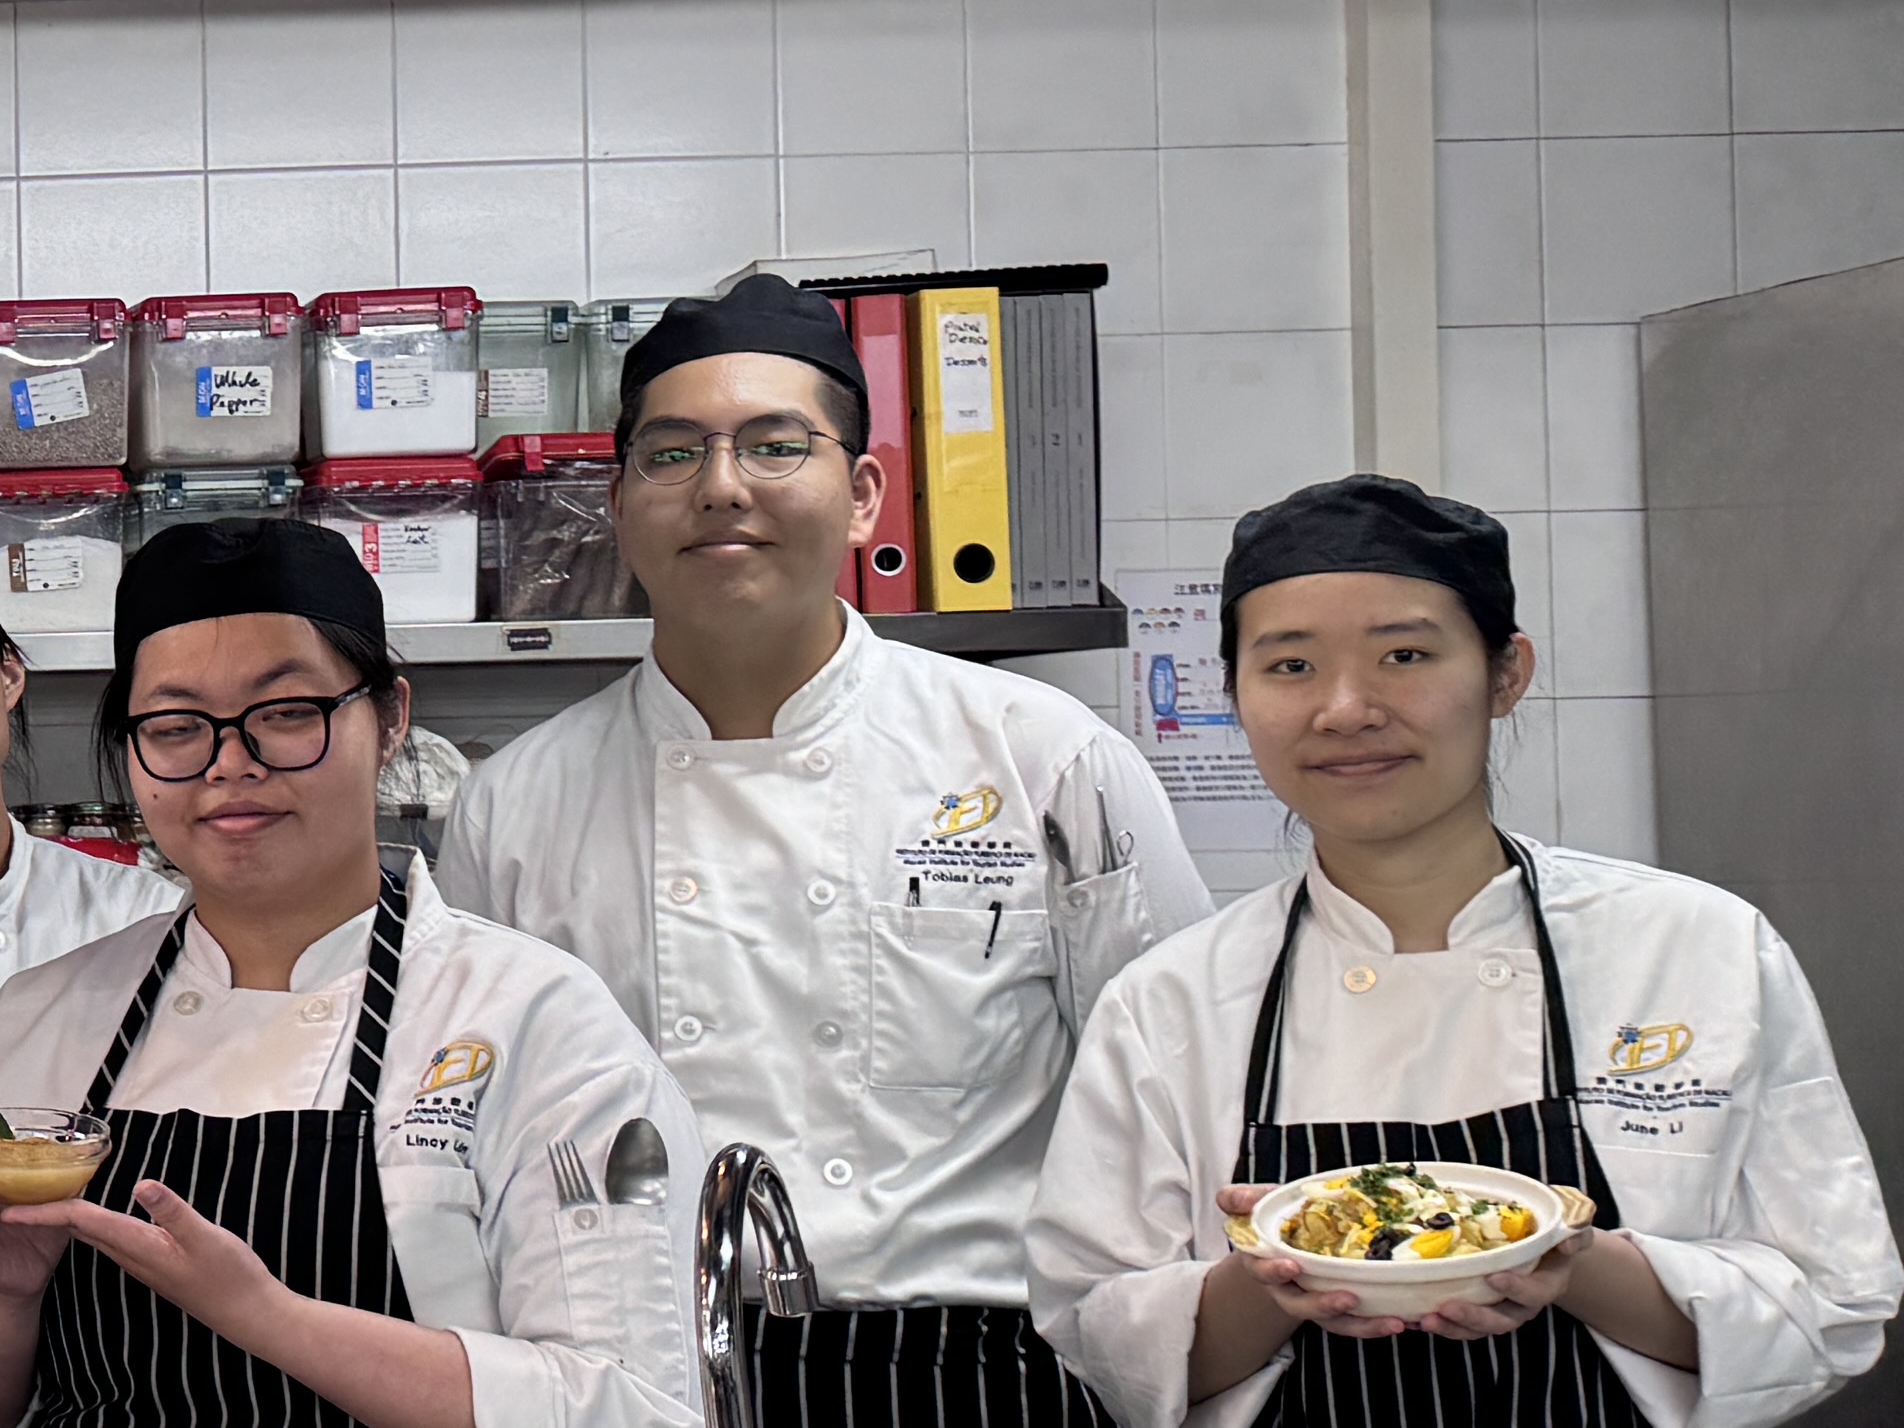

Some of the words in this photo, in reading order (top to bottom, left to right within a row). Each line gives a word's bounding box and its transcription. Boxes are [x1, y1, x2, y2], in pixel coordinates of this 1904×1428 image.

[921, 871, 969, 884] Tobias
[974, 874, 1015, 887] Leung
[1621, 1120, 1660, 1136] June
